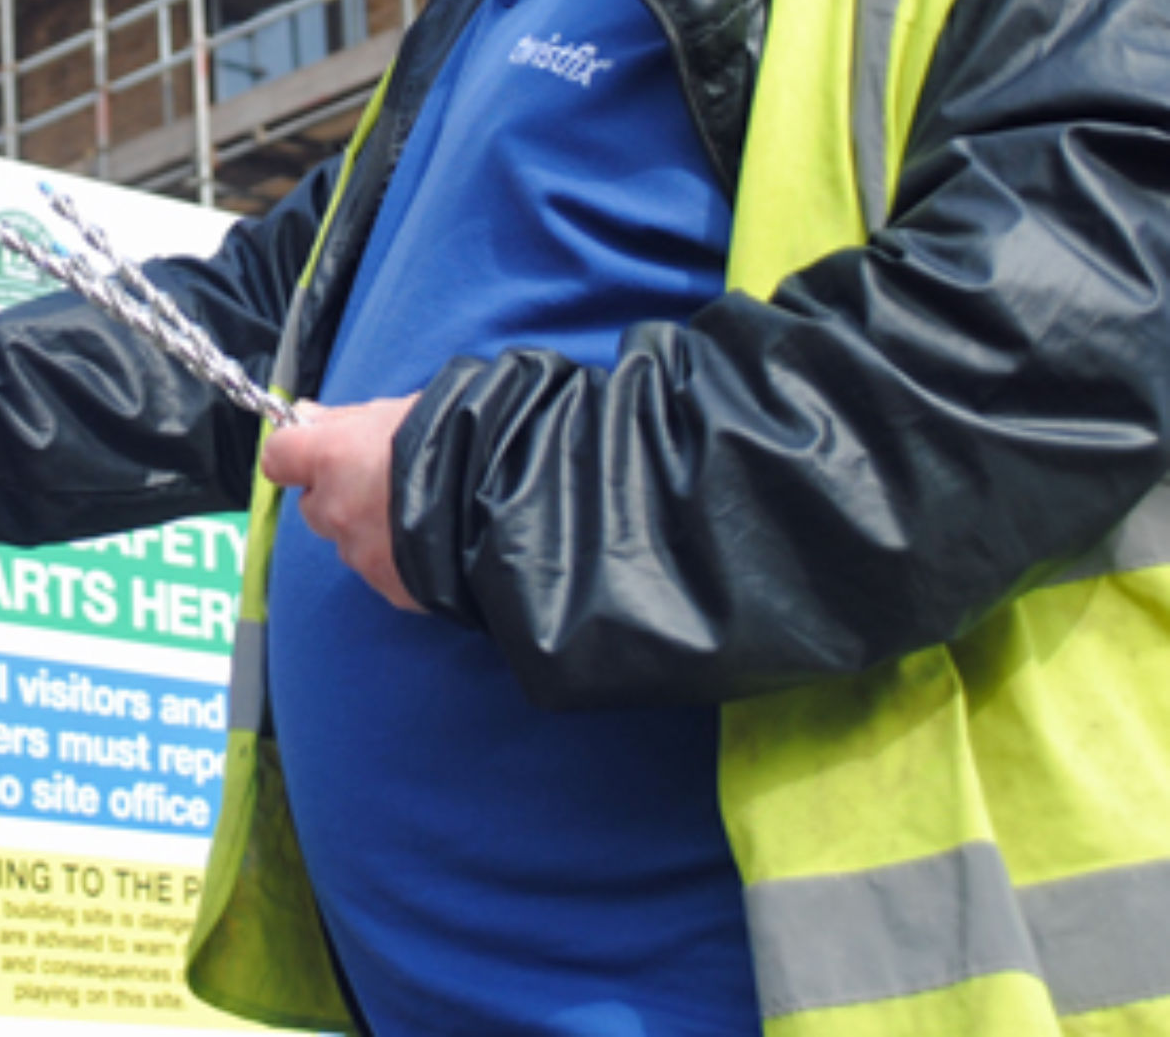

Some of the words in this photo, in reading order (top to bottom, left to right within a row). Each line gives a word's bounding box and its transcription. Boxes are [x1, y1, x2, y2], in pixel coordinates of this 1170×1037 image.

[68, 516, 245, 577] FETY
[132, 576, 241, 644] HER
[17, 668, 151, 721] visitors
[159, 693, 227, 731] and
[57, 731, 150, 771] must
[158, 742, 228, 786] repo
[31, 771, 100, 816] site
[107, 781, 212, 827] office
[62, 862, 105, 898] TO
[112, 867, 173, 903] THE
[4, 899, 76, 928] building
[1, 956, 36, 974] and
[13, 983, 79, 1009] playing
